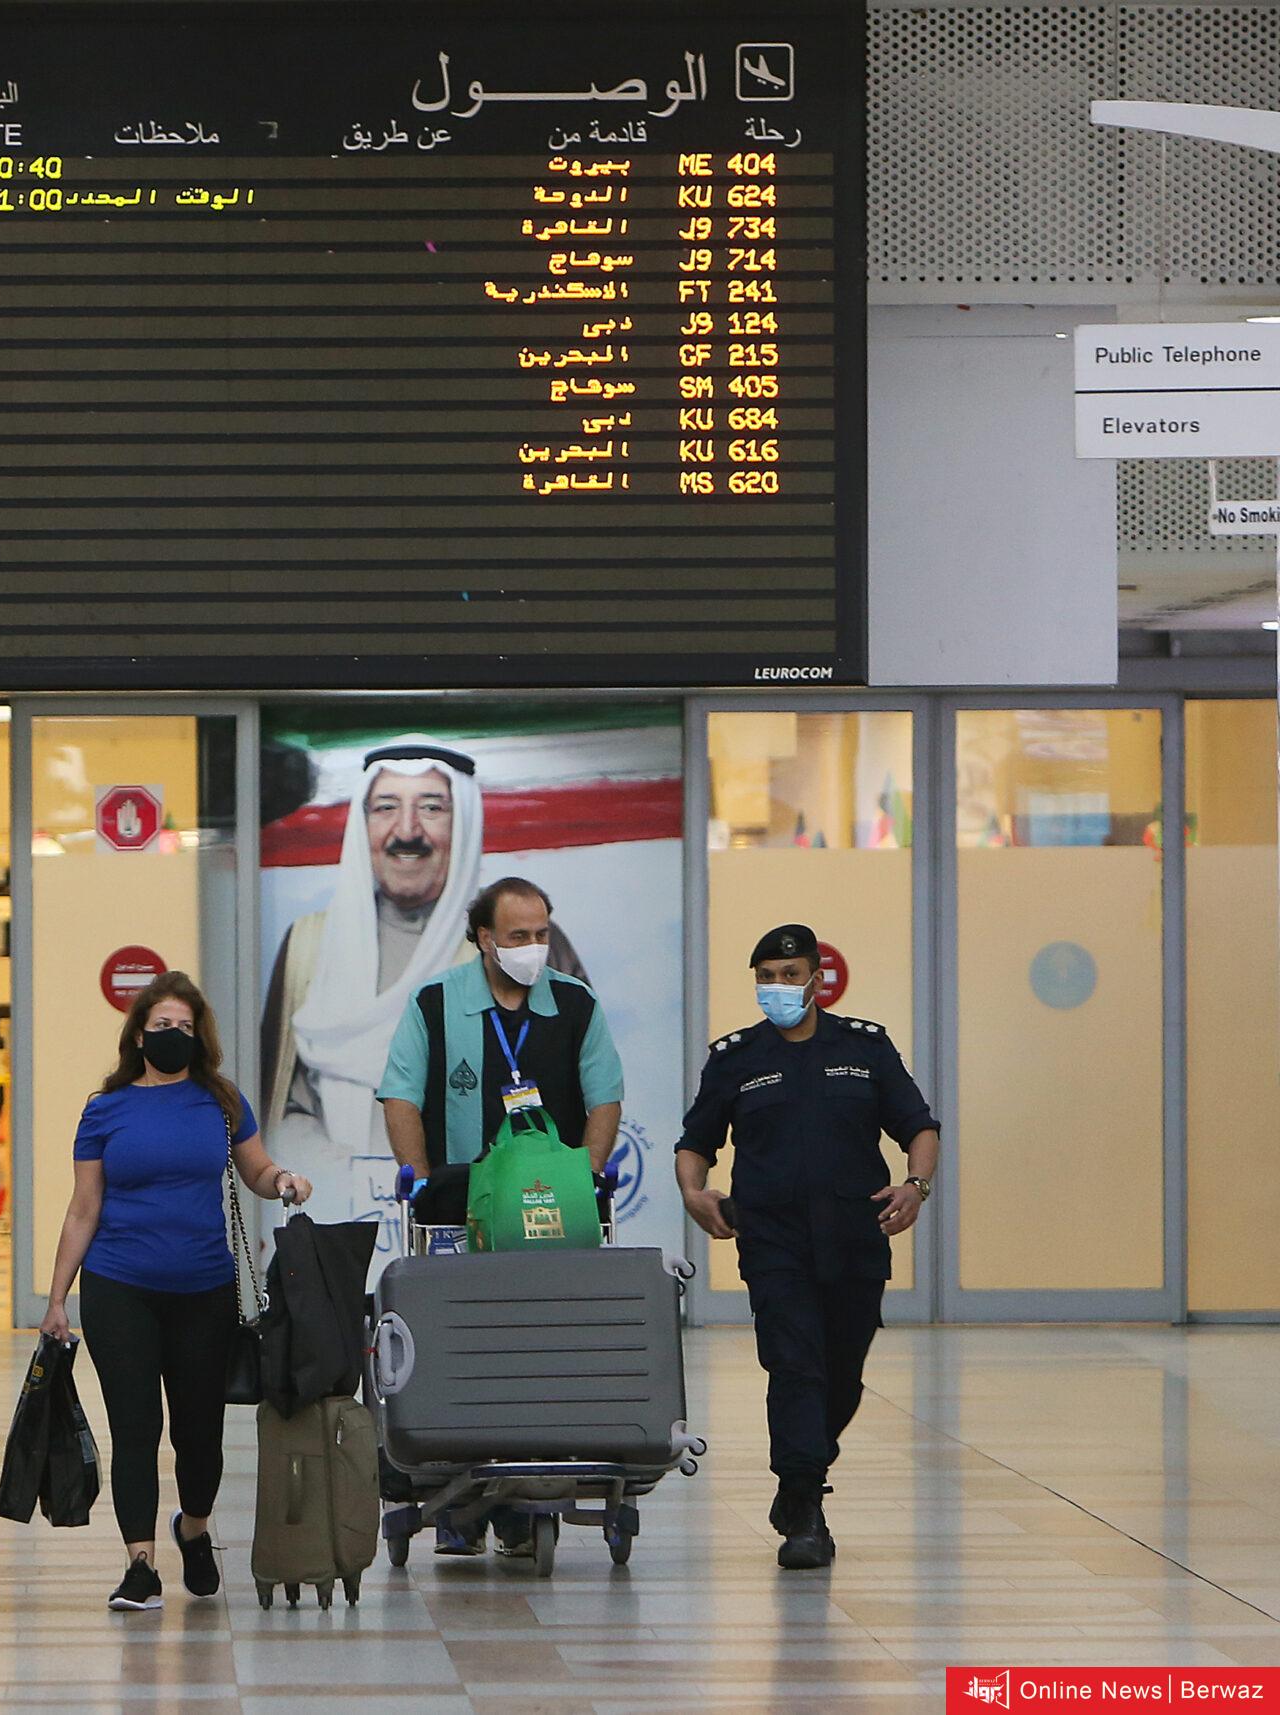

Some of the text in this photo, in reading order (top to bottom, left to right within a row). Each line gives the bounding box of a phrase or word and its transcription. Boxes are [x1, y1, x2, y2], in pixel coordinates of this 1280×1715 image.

[114, 120, 220, 145] ملاحظات
[342, 119, 452, 151] عن طريق
[548, 120, 648, 150] قادمة من
[744, 117, 802, 148] رحلة
[548, 156, 631, 177] بيروت
[678, 152, 777, 177] ME 404
[66, 187, 254, 210] الوقت المحدد
[533, 186, 627, 209] الدوحة
[678, 184, 777, 209] KU 624
[521, 219, 628, 241] القاهرة
[678, 216, 777, 241] J9 734
[548, 251, 634, 275] سوهاج
[678, 248, 777, 272] J9 714
[678, 279, 778, 303] FT 241
[680, 311, 779, 335] J9 124
[518, 345, 629, 368] البحرين
[678, 343, 779, 367] GF 215
[1095, 345, 1262, 366] Public Telephone
[550, 378, 636, 402] سوهاج
[679, 375, 779, 399] SM 405
[679, 407, 779, 431] KU 684
[1102, 416, 1201, 434] Elevators
[518, 440, 629, 463] البحرين
[679, 439, 779, 463] KU 616
[522, 473, 629, 495] القاهرة
[679, 470, 780, 494] MS 620
[1217, 507, 1236, 524] No
[753, 666, 834, 681] LEUROCOM
